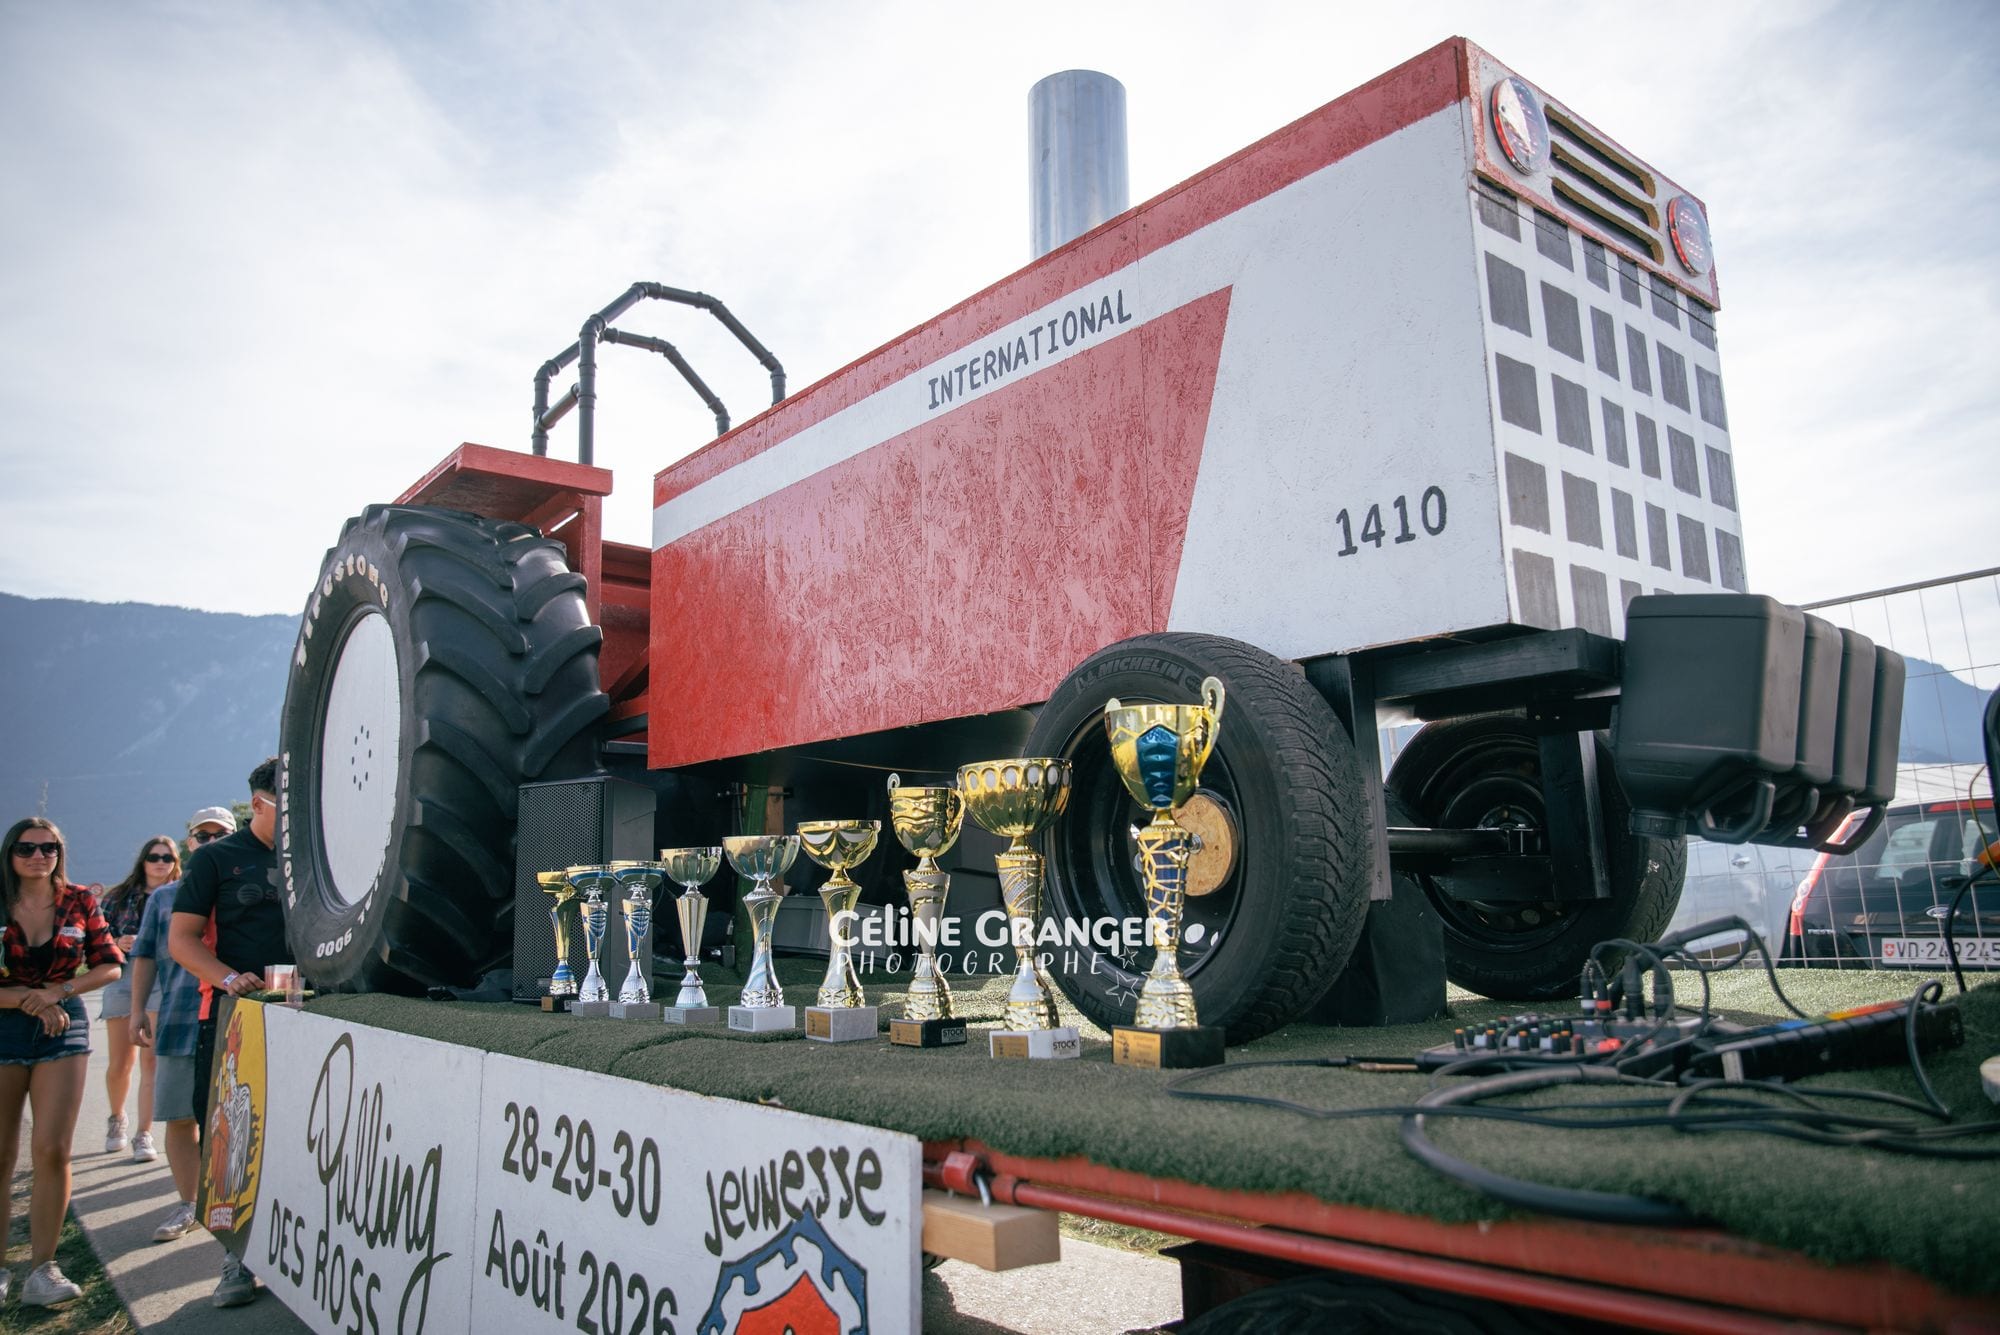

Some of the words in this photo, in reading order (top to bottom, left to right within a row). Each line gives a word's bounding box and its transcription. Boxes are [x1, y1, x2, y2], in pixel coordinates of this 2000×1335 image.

[928, 289, 1132, 410] INTERNATIONAL
[1336, 485, 1447, 557] 1410
[1098, 655, 1184, 682] MICHELIN
[316, 927, 352, 958] 9000
[943, 1027, 965, 1037] STOCK
[1053, 1040, 1077, 1050] STOCK
[307, 1032, 453, 1335] Pulling
[502, 1101, 661, 1226] 28-29-30
[268, 1198, 305, 1288] DES
[485, 1208, 566, 1320] Août
